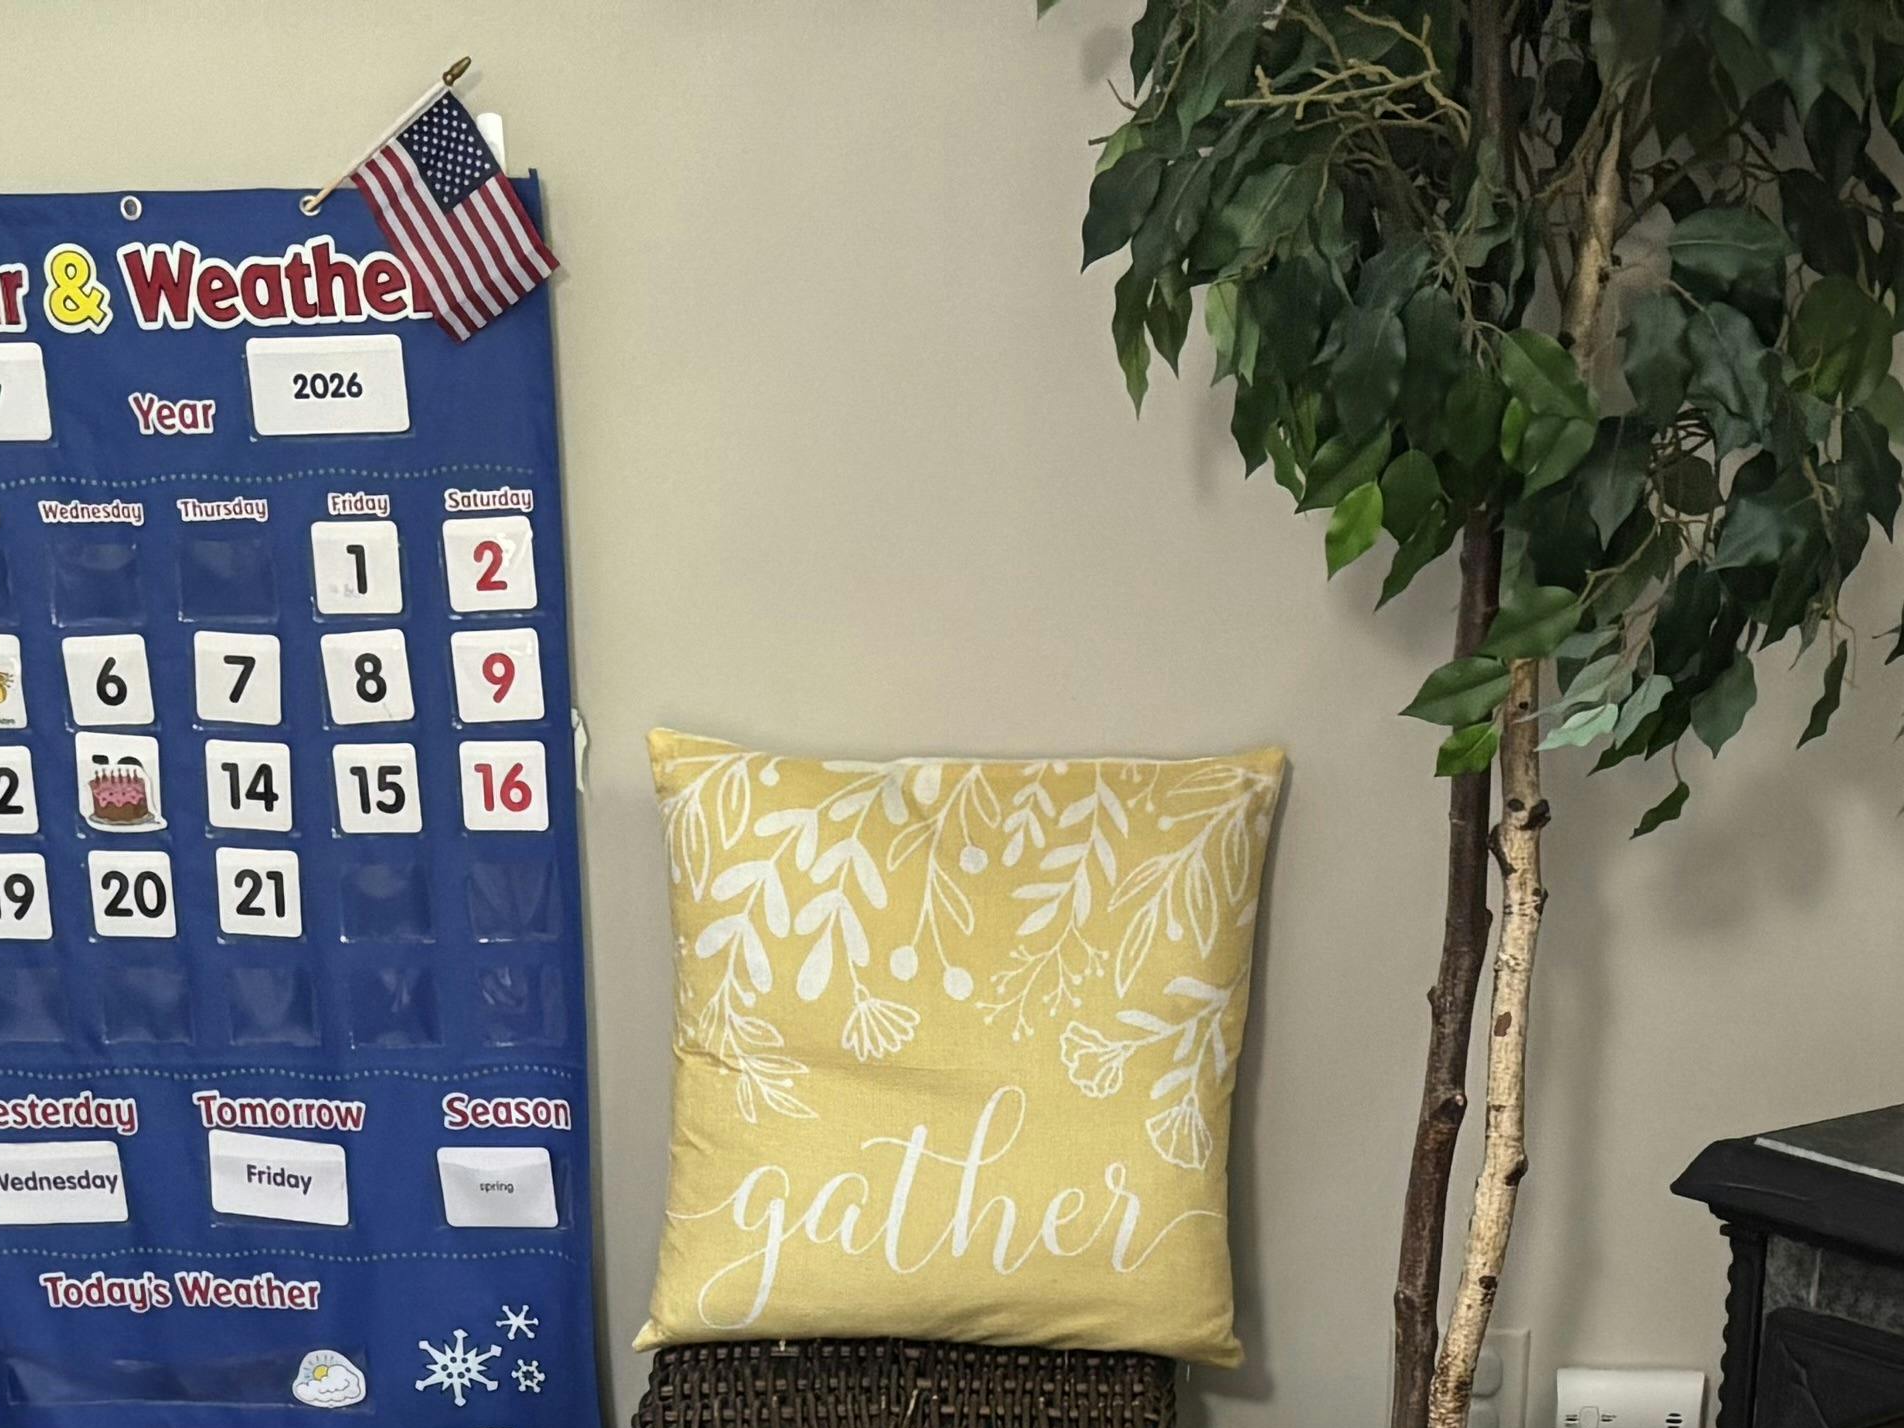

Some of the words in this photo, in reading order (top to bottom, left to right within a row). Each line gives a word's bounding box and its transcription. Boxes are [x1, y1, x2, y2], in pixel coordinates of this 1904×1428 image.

[47, 247, 109, 331] &
[130, 394, 214, 434] Year
[292, 373, 363, 399] 2026
[40, 501, 143, 526] Wednesday
[179, 499, 267, 522] Thursday
[329, 493, 389, 517] Friday
[446, 488, 532, 512] Saturday
[346, 544, 368, 594] 1
[473, 540, 507, 591] 2
[96, 656, 127, 706] 6
[223, 655, 256, 703] 7
[354, 653, 387, 703] 8
[482, 653, 515, 703] 9
[221, 762, 279, 812] 14
[350, 766, 405, 815] 15
[474, 763, 532, 812] 16
[101, 870, 166, 918] 20
[234, 869, 285, 918] 21
[194, 1092, 364, 1130] Tomorrow
[443, 1093, 571, 1129] Season
[246, 1165, 312, 1195] Friday
[479, 1181, 514, 1193] spring
[664, 1085, 1226, 1330] gather
[41, 1274, 170, 1312] Today's
[176, 1272, 320, 1309] Weather
